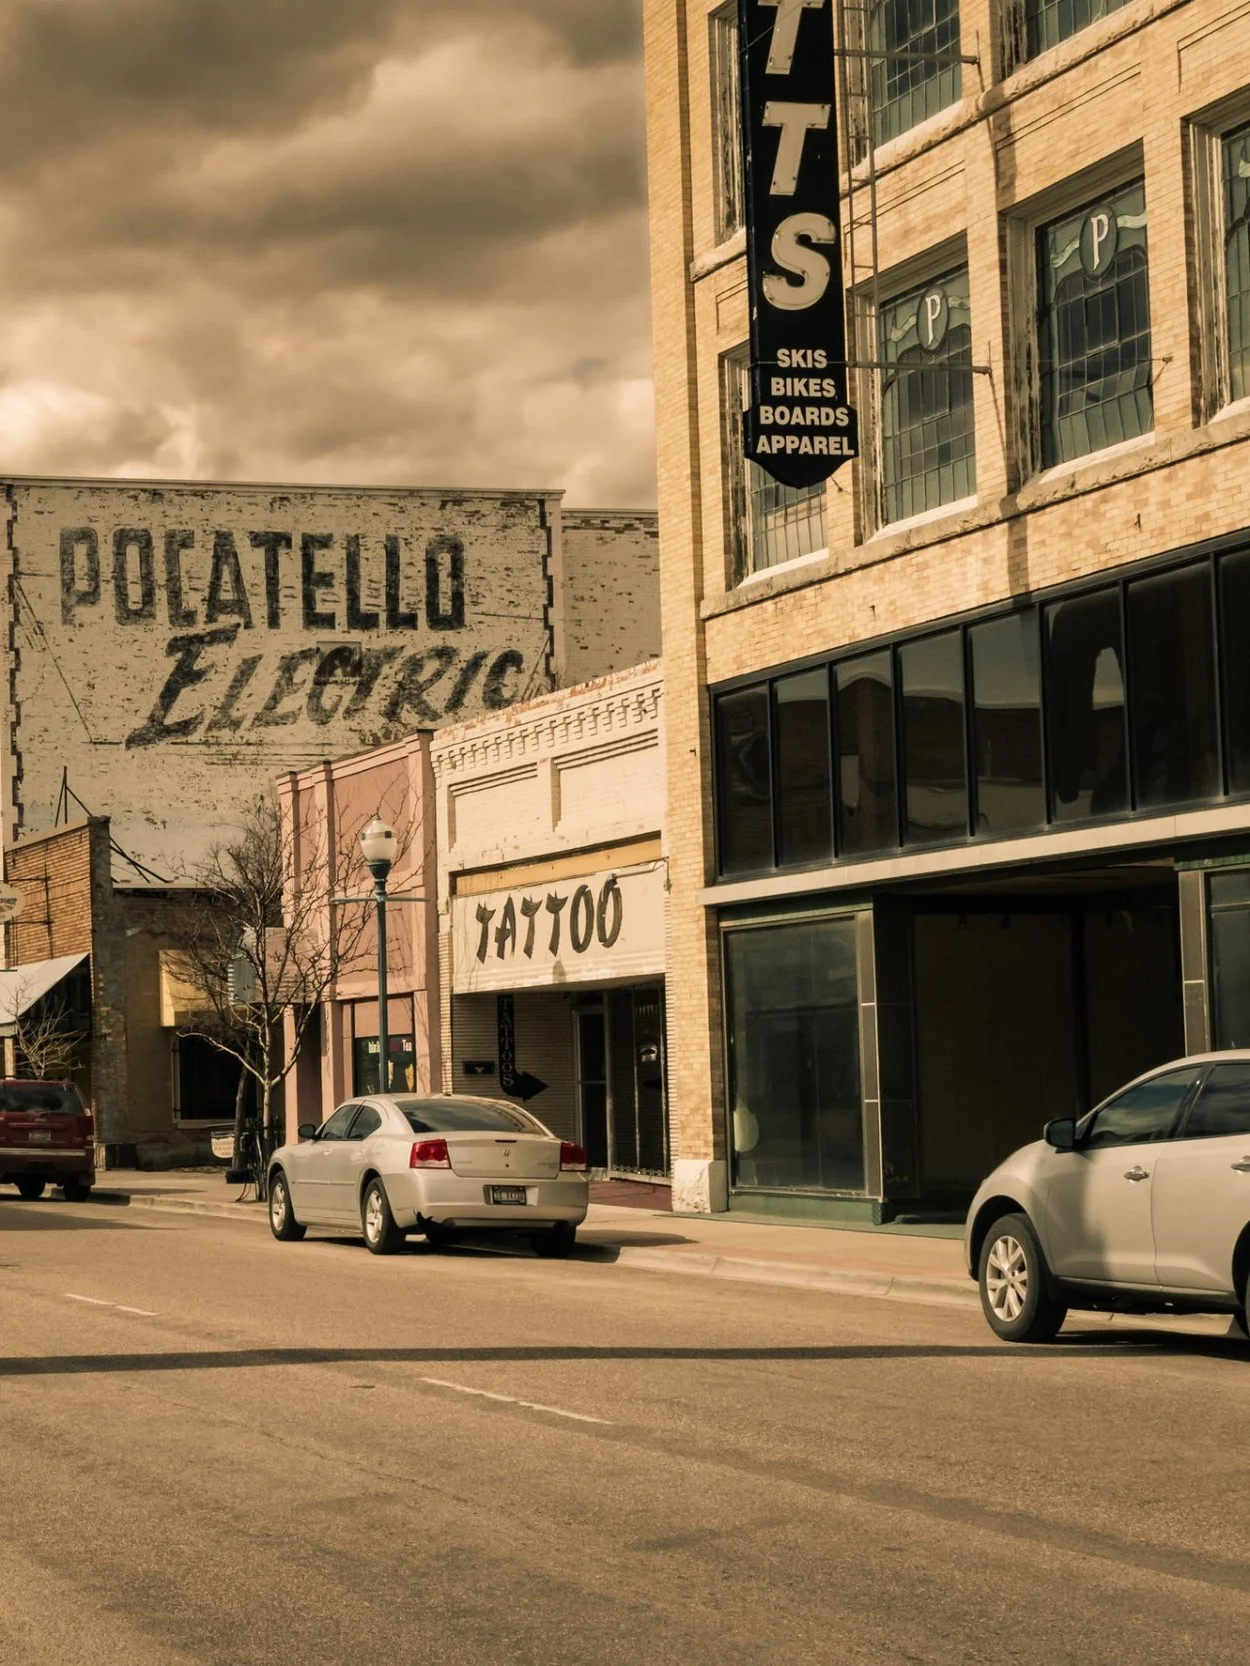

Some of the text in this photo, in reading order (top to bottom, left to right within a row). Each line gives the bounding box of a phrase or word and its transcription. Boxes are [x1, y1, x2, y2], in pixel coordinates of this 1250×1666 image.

[1090, 213, 1109, 271] P
[925, 293, 941, 346] P
[776, 348, 828, 369] SKIS
[771, 377, 836, 398] BIKES
[759, 405, 849, 427] BOARDS
[756, 434, 855, 456] APPAREL
[59, 525, 466, 632] POCATELLO
[125, 622, 524, 751] ELECTRIC
[475, 876, 623, 965] TATTOO
